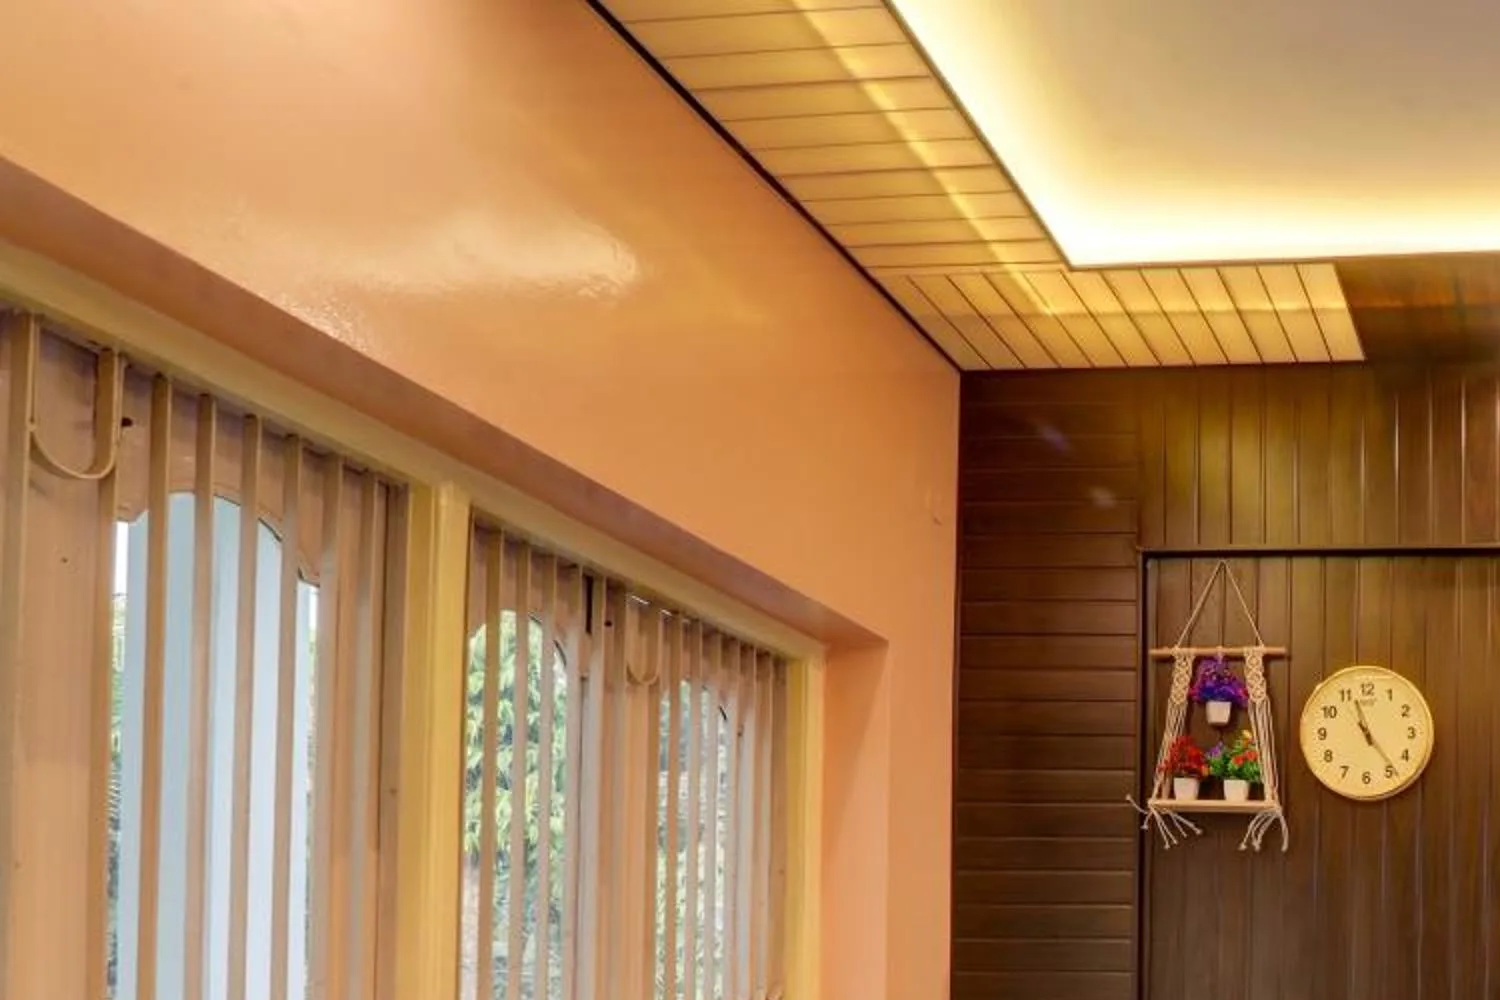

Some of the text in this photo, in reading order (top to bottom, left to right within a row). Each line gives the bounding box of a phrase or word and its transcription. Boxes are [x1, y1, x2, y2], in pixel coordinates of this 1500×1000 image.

[1340, 689, 1351, 701] 11
[1361, 683, 1374, 696] 12
[1387, 689, 1392, 700] 1
[1322, 706, 1337, 718] 10
[1401, 704, 1410, 717] 2
[1318, 728, 1326, 740] 9
[1408, 727, 1416, 739] 3
[1324, 750, 1332, 762] 8
[1401, 750, 1408, 761] 4
[1340, 766, 1348, 778] 7
[1384, 765, 1393, 778] 5
[1362, 772, 1370, 784] 6
